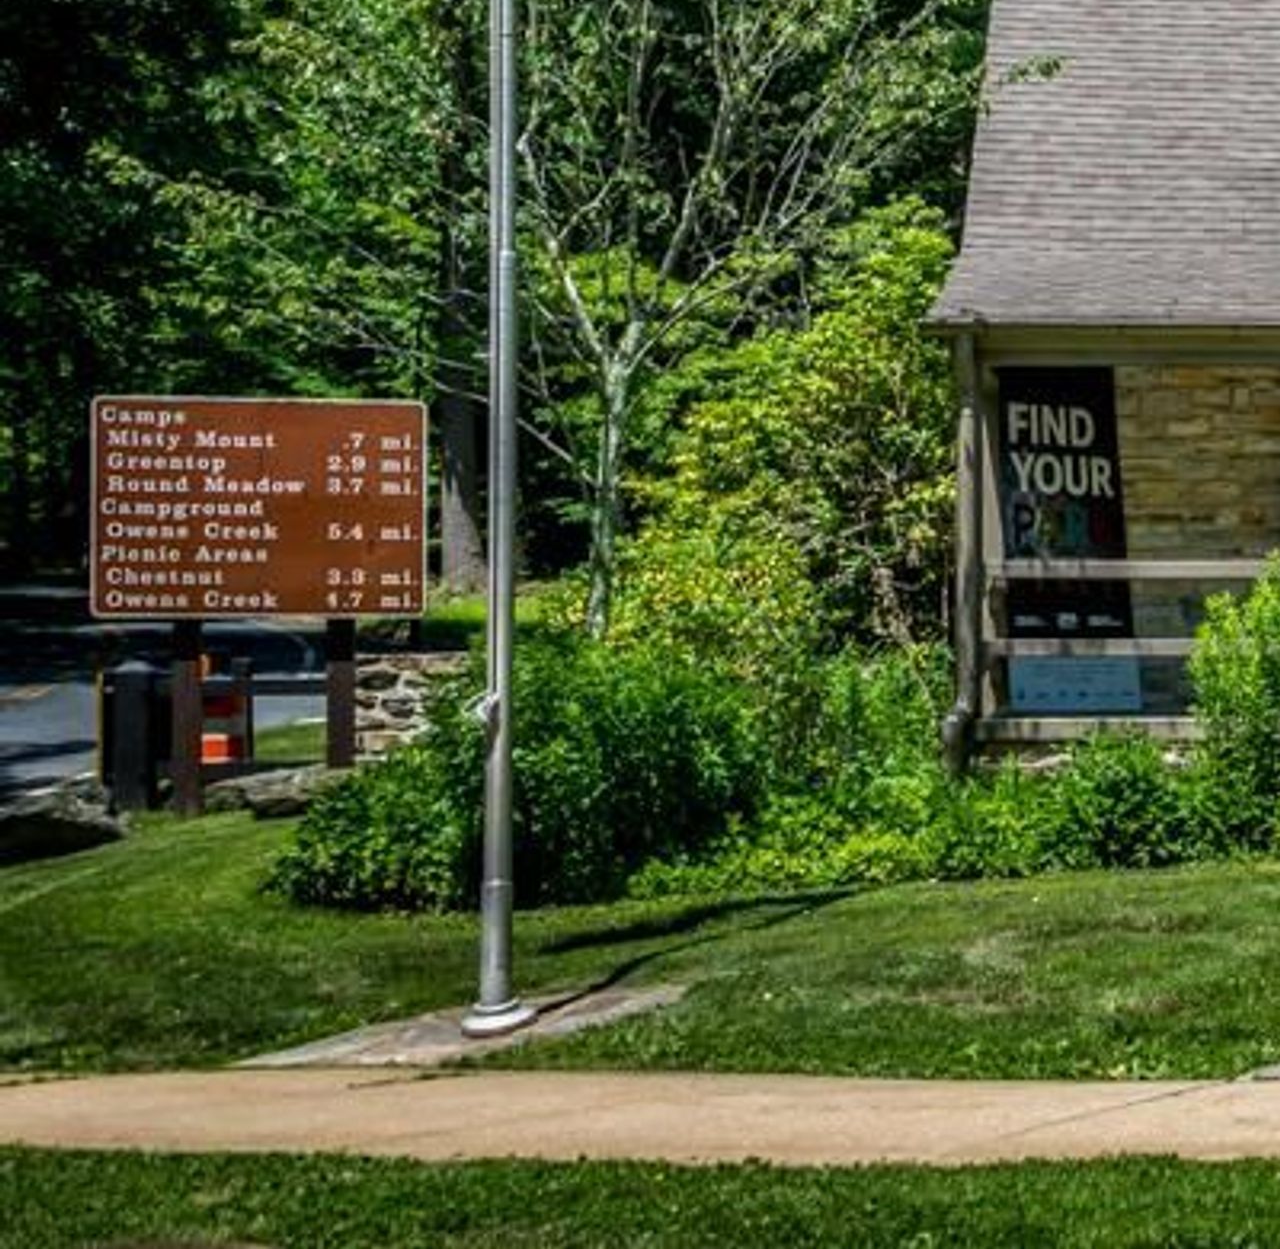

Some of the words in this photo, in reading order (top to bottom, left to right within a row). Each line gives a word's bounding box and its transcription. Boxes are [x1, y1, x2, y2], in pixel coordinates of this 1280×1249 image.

[102, 407, 186, 427] Camps
[1008, 402, 1096, 447] FIND
[107, 430, 181, 451] Misty
[194, 431, 277, 448] Mount
[108, 452, 226, 474] Greentop
[108, 475, 189, 492] Round
[203, 476, 305, 493] Meadow
[1010, 452, 1115, 498] YOUR
[102, 498, 264, 520] Campground
[106, 522, 190, 538] Owens
[204, 522, 279, 540] Creek
[102, 546, 181, 563] Picnic
[195, 546, 269, 562] Areas
[106, 568, 224, 585] Chestnut
[105, 590, 190, 608] Owens
[204, 590, 278, 608] Creek
